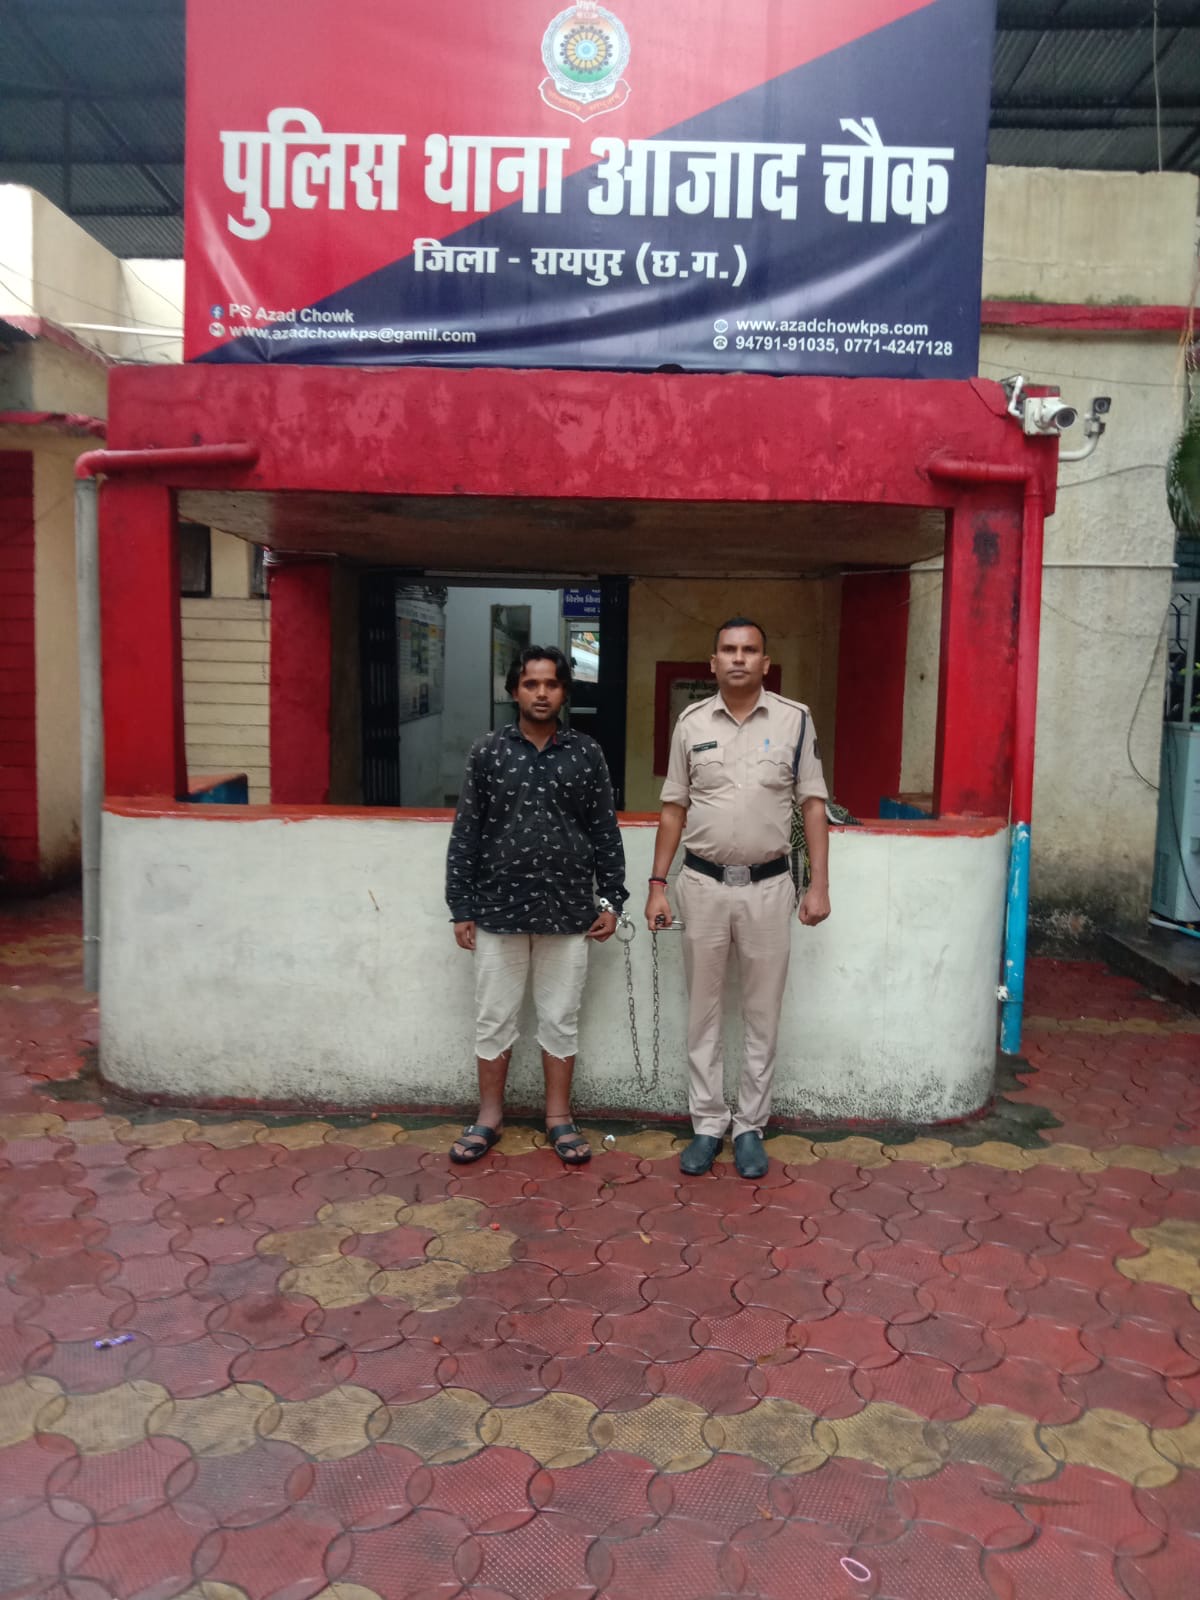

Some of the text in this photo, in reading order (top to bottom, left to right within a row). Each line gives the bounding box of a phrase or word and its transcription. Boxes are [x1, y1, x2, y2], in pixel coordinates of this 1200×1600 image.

[219, 107, 955, 241] पुलिस थाना आजाद चौक
[413, 238, 499, 273] जिला
[531, 247, 625, 286] रायपुर
[636, 241, 747, 287] (छ.ग.)
[229, 304, 354, 323] PS Azad Chowk
[229, 326, 476, 343] www.azadchowkps@gamil.com
[736, 318, 928, 336] www.azadchowkps.com
[735, 336, 953, 356] 94791-91035, 0771-4247128
